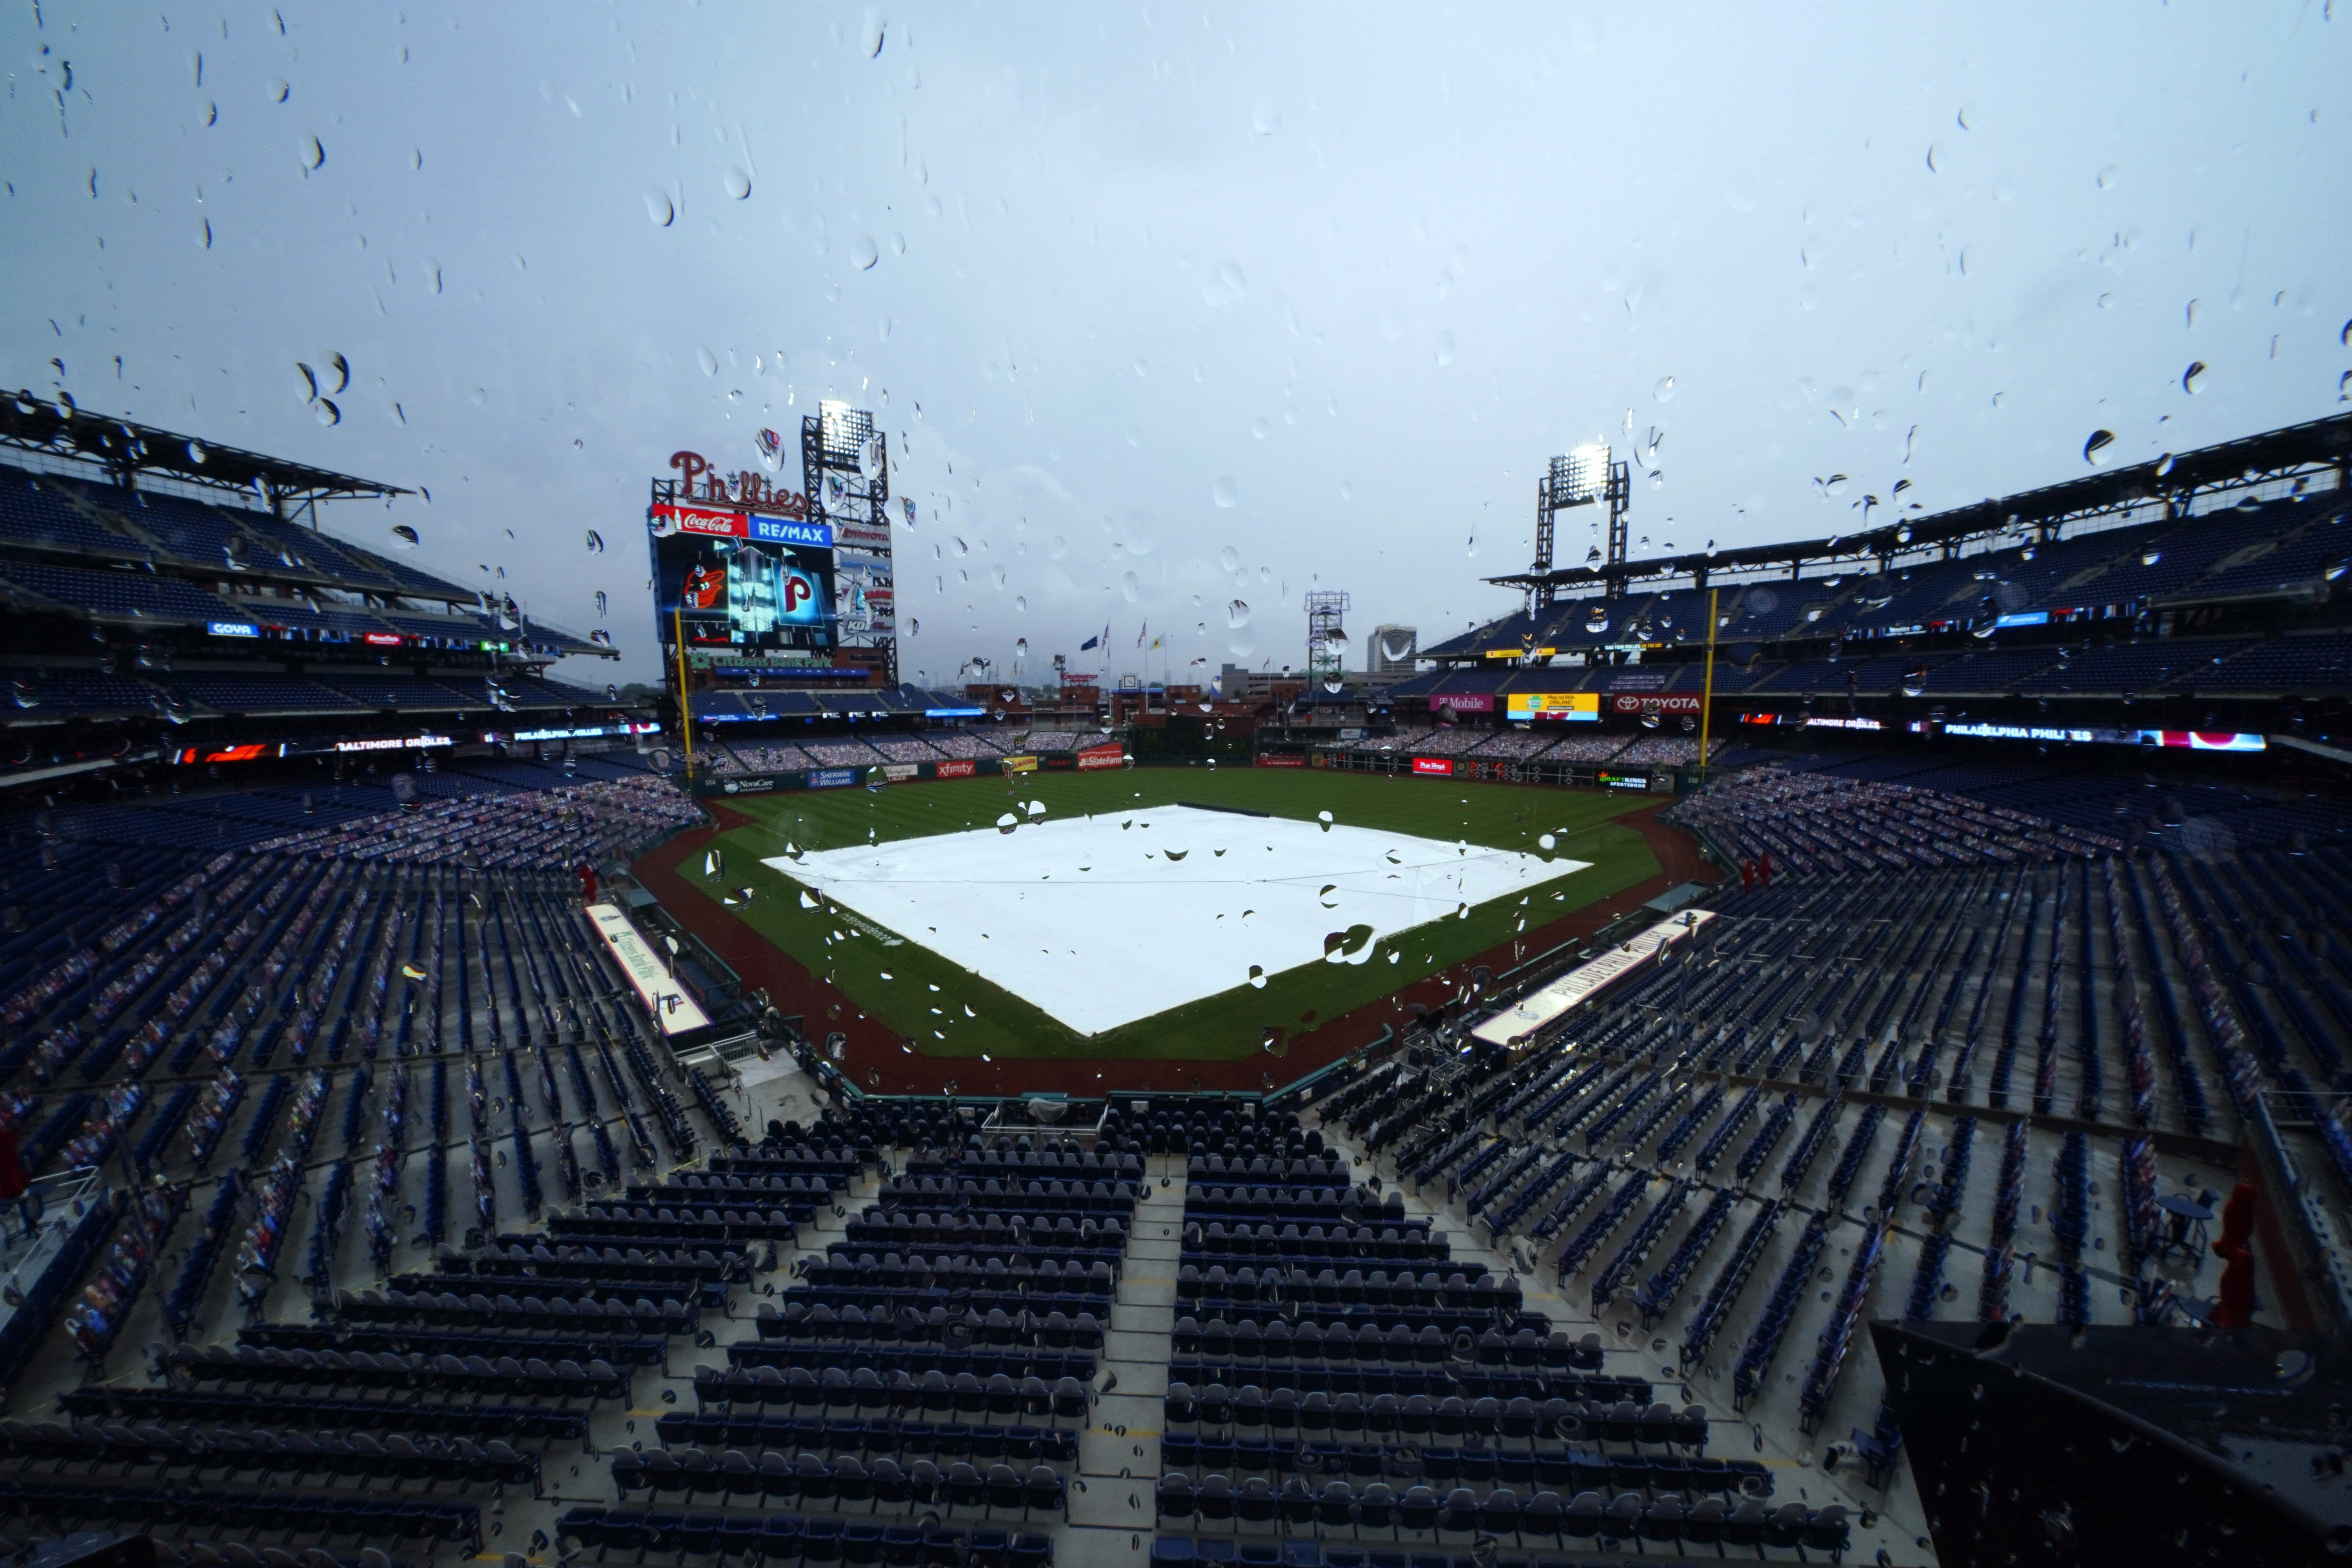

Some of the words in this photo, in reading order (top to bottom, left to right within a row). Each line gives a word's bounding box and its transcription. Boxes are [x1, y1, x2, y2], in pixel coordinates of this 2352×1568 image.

[670, 451, 809, 512] Phllies
[684, 514, 733, 532] Coca-Cola
[759, 522, 823, 542] RE/MAX
[214, 624, 250, 634] GOYA
[713, 655, 768, 668] Citizens
[770, 656, 802, 668] Bank
[804, 656, 832, 668] Park
[1641, 698, 1700, 708] TOYOTA
[1805, 718, 1844, 727] ALTIMORE
[1845, 720, 1880, 730] ORIOLES
[515, 730, 571, 740] PHILADELPHIA
[1945, 724, 2029, 739] PHILADELPHIA
[2030, 728, 2092, 742] PHILLES
[336, 739, 403, 751] BALTIMORE
[405, 737, 450, 747] ORIOLES
[1089, 756, 1122, 766] SateFarm
[940, 763, 973, 777] xfinity
[740, 779, 774, 788] NovaCare
[619, 938, 638, 956] Citizens
[1549, 953, 1638, 998] PHILADELPHIA
[1629, 931, 1674, 954] PHILLIES
